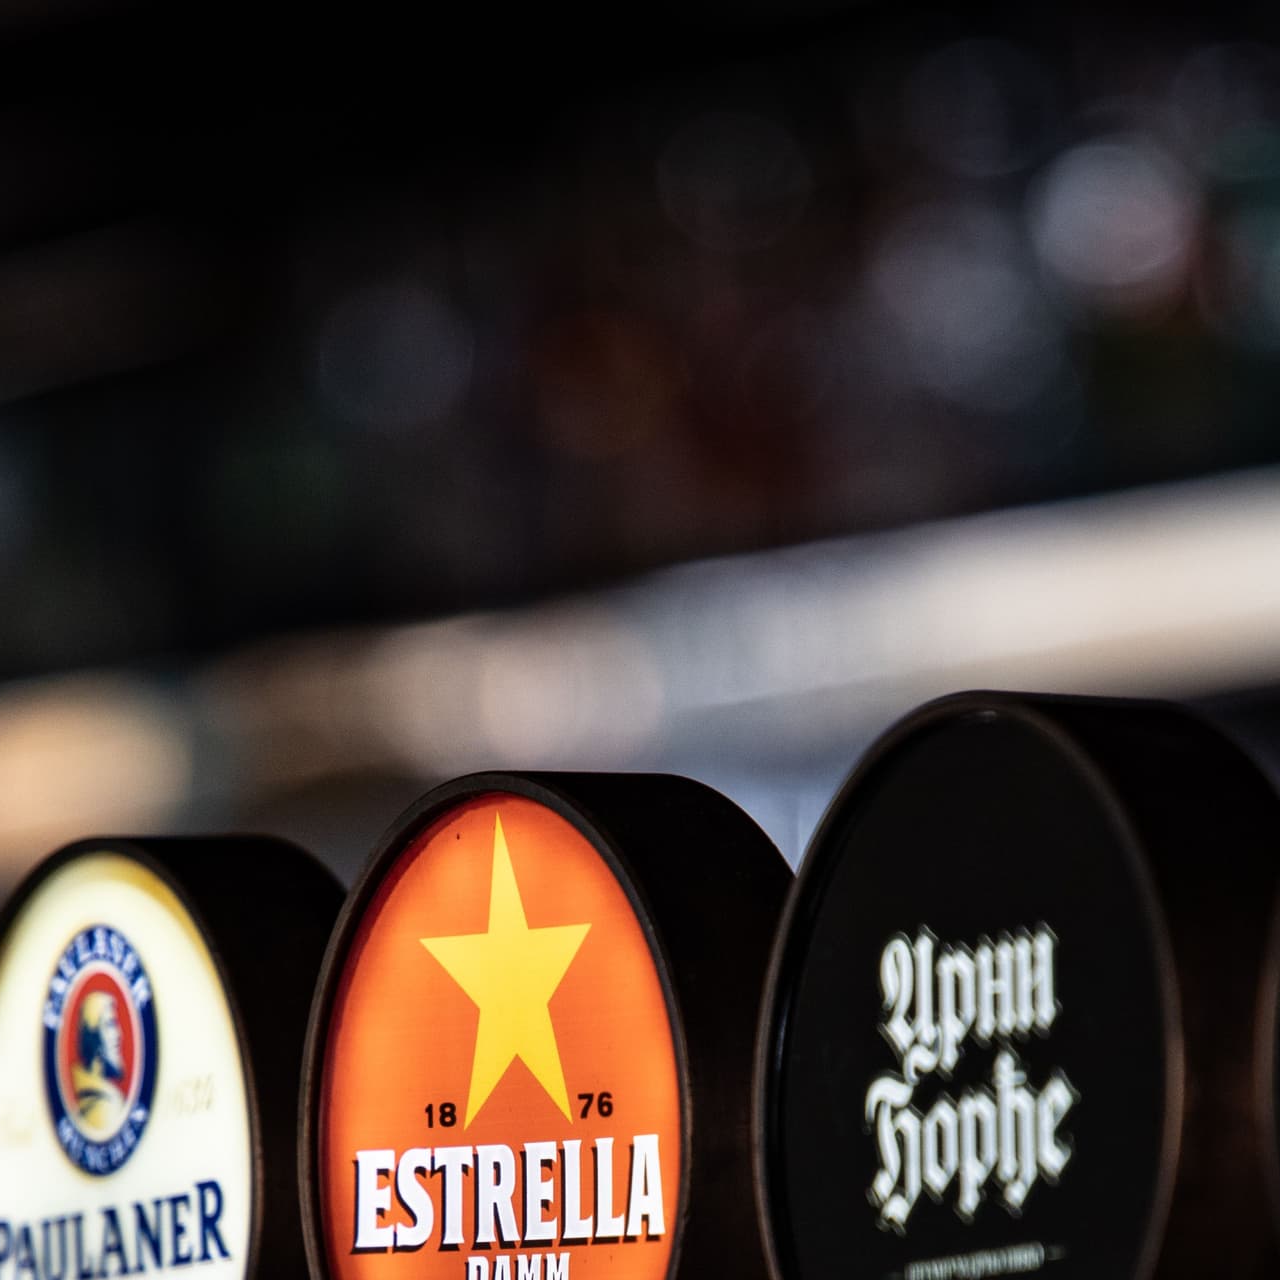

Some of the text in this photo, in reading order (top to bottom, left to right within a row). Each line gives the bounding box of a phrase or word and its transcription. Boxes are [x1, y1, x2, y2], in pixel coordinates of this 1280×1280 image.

[424, 1092, 614, 1128] 18 76
[350, 1134, 666, 1254] ESTRELLA
